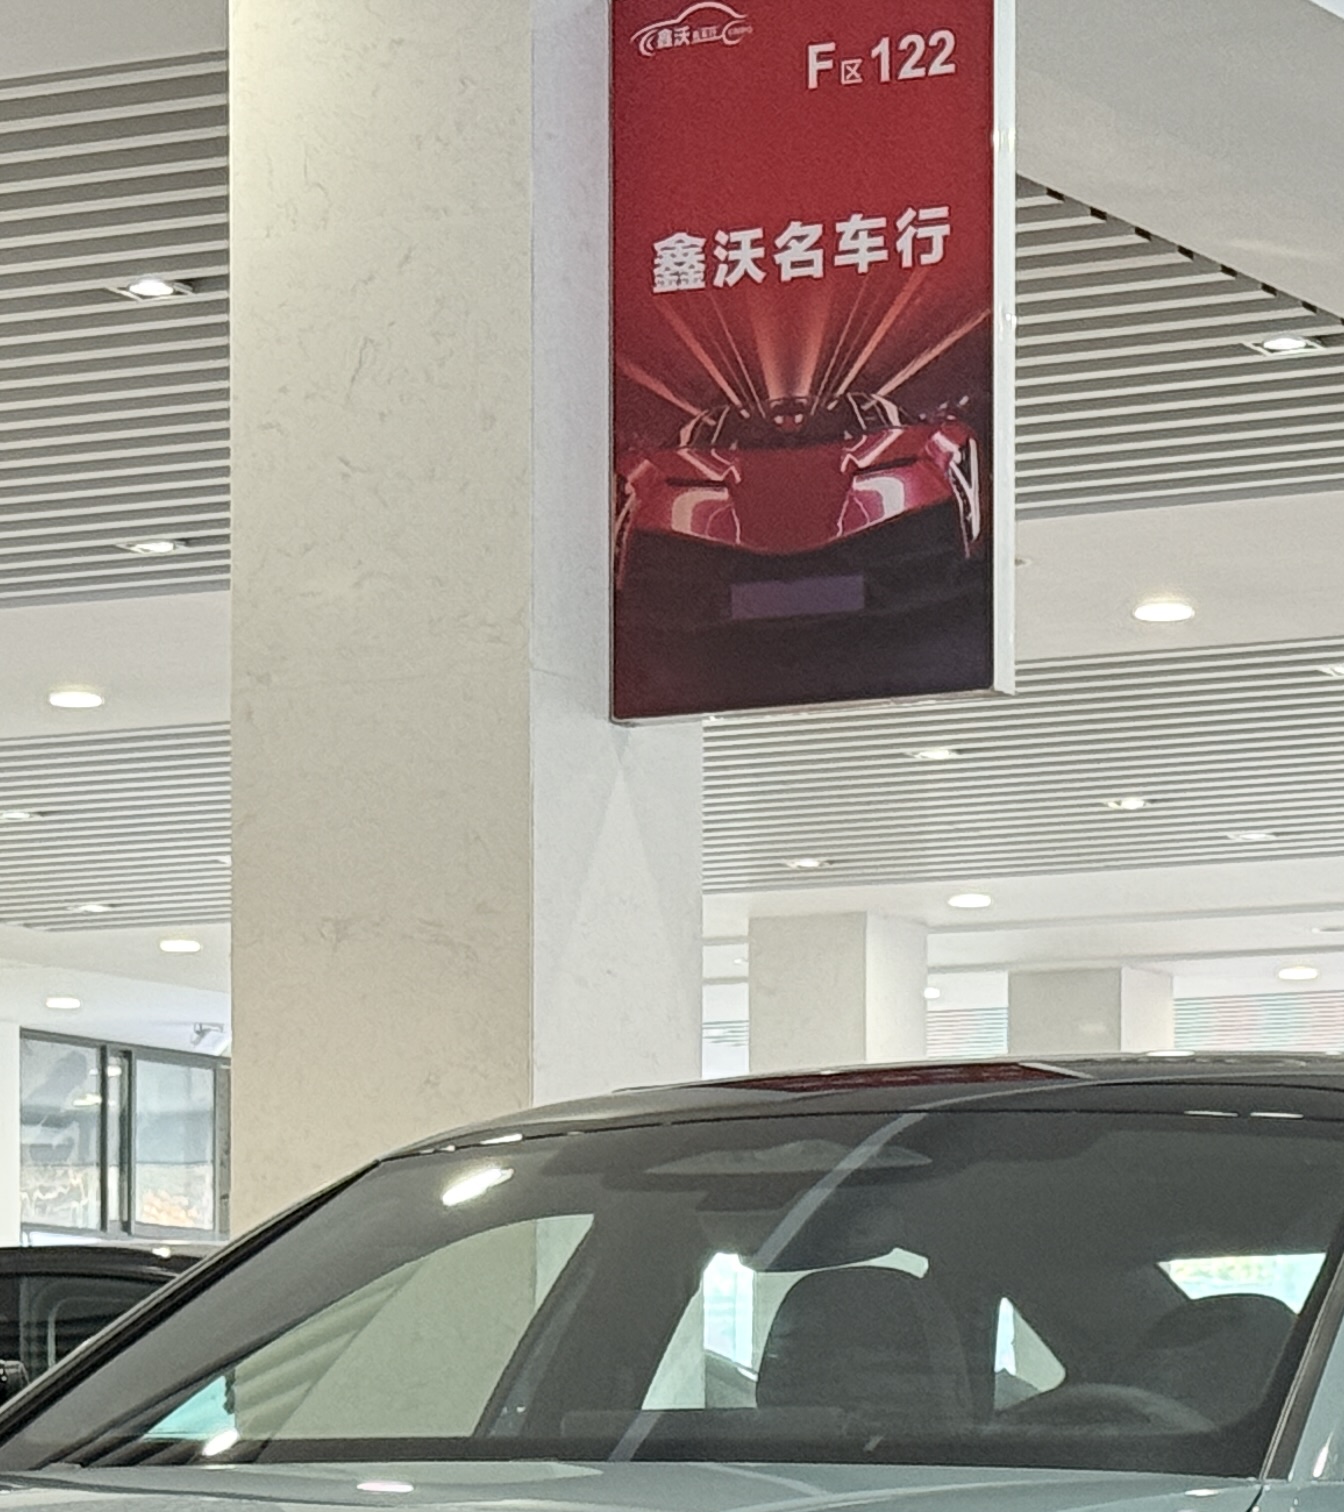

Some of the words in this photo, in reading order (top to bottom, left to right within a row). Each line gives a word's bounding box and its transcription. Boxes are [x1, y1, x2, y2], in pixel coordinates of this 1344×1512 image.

[806, 30, 956, 89] F区122
[653, 206, 951, 293] 鑫沃名车行
